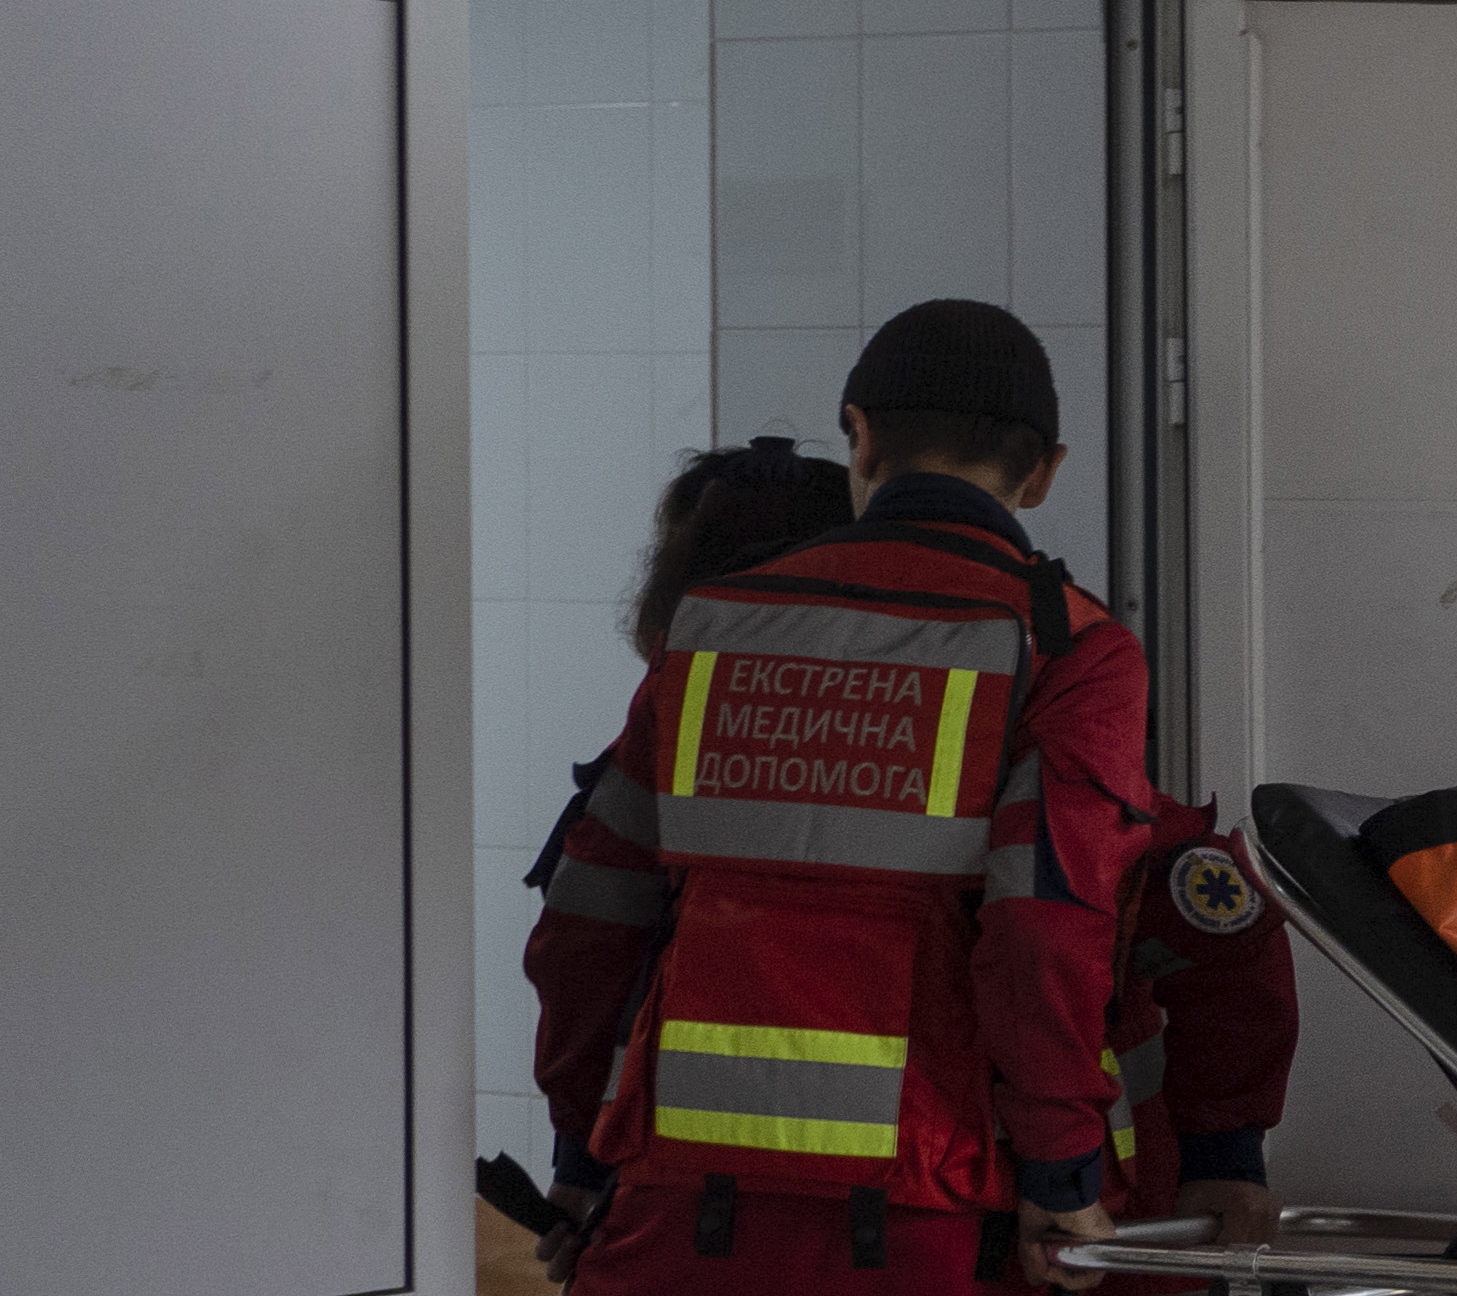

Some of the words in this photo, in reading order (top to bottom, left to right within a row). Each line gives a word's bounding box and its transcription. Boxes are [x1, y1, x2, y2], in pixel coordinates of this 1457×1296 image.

[729, 658, 923, 706] ЕКСТРЕНА
[716, 703, 917, 752] МЕДИЧНА
[694, 751, 927, 805] ДОПОМОГА
